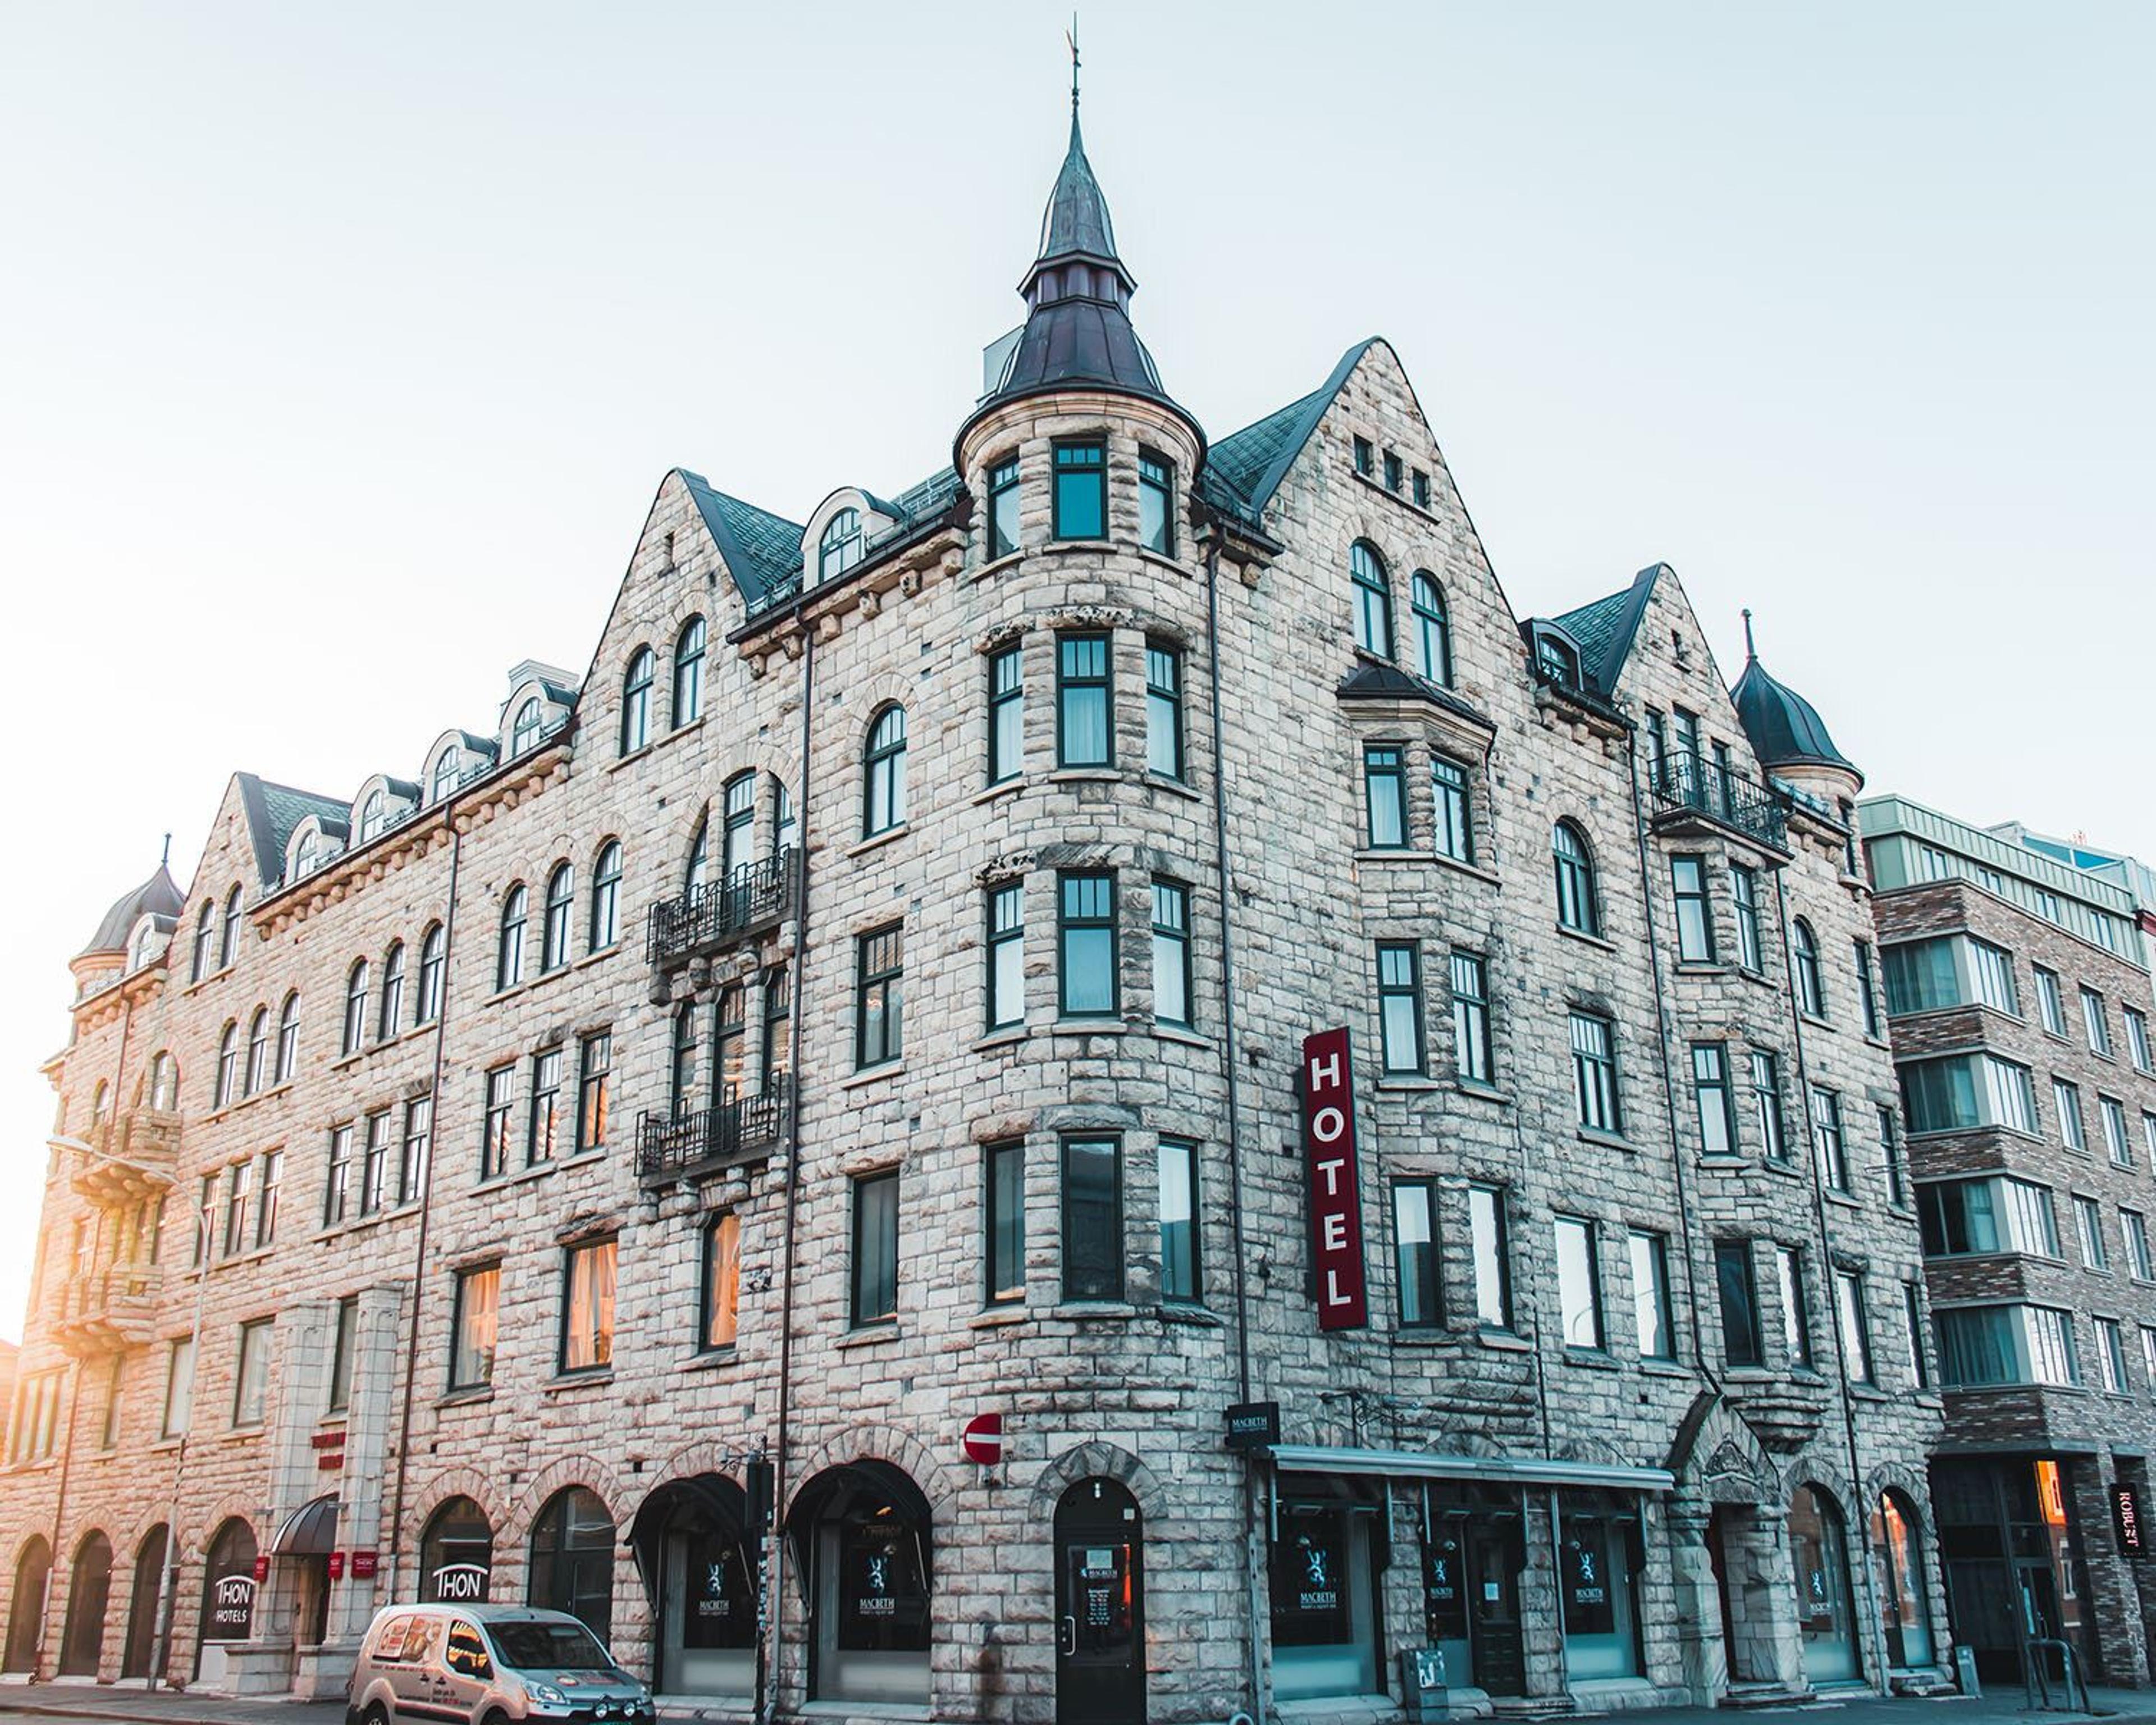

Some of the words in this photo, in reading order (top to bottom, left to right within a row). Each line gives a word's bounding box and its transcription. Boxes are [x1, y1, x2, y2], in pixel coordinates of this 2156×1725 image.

[1310, 1052, 1351, 1306] HOTEL
[1232, 1416, 1267, 1428] MACBETH
[2119, 1492, 2139, 1547] ROBUST
[432, 1563, 488, 1598] THON
[216, 1575, 255, 1604] THON
[1300, 1590, 1336, 1603] MACBETH
[700, 1600, 729, 1610] MACBETH
[859, 1598, 895, 1610] MACBETH
[216, 1609, 247, 1622] HOTELS
